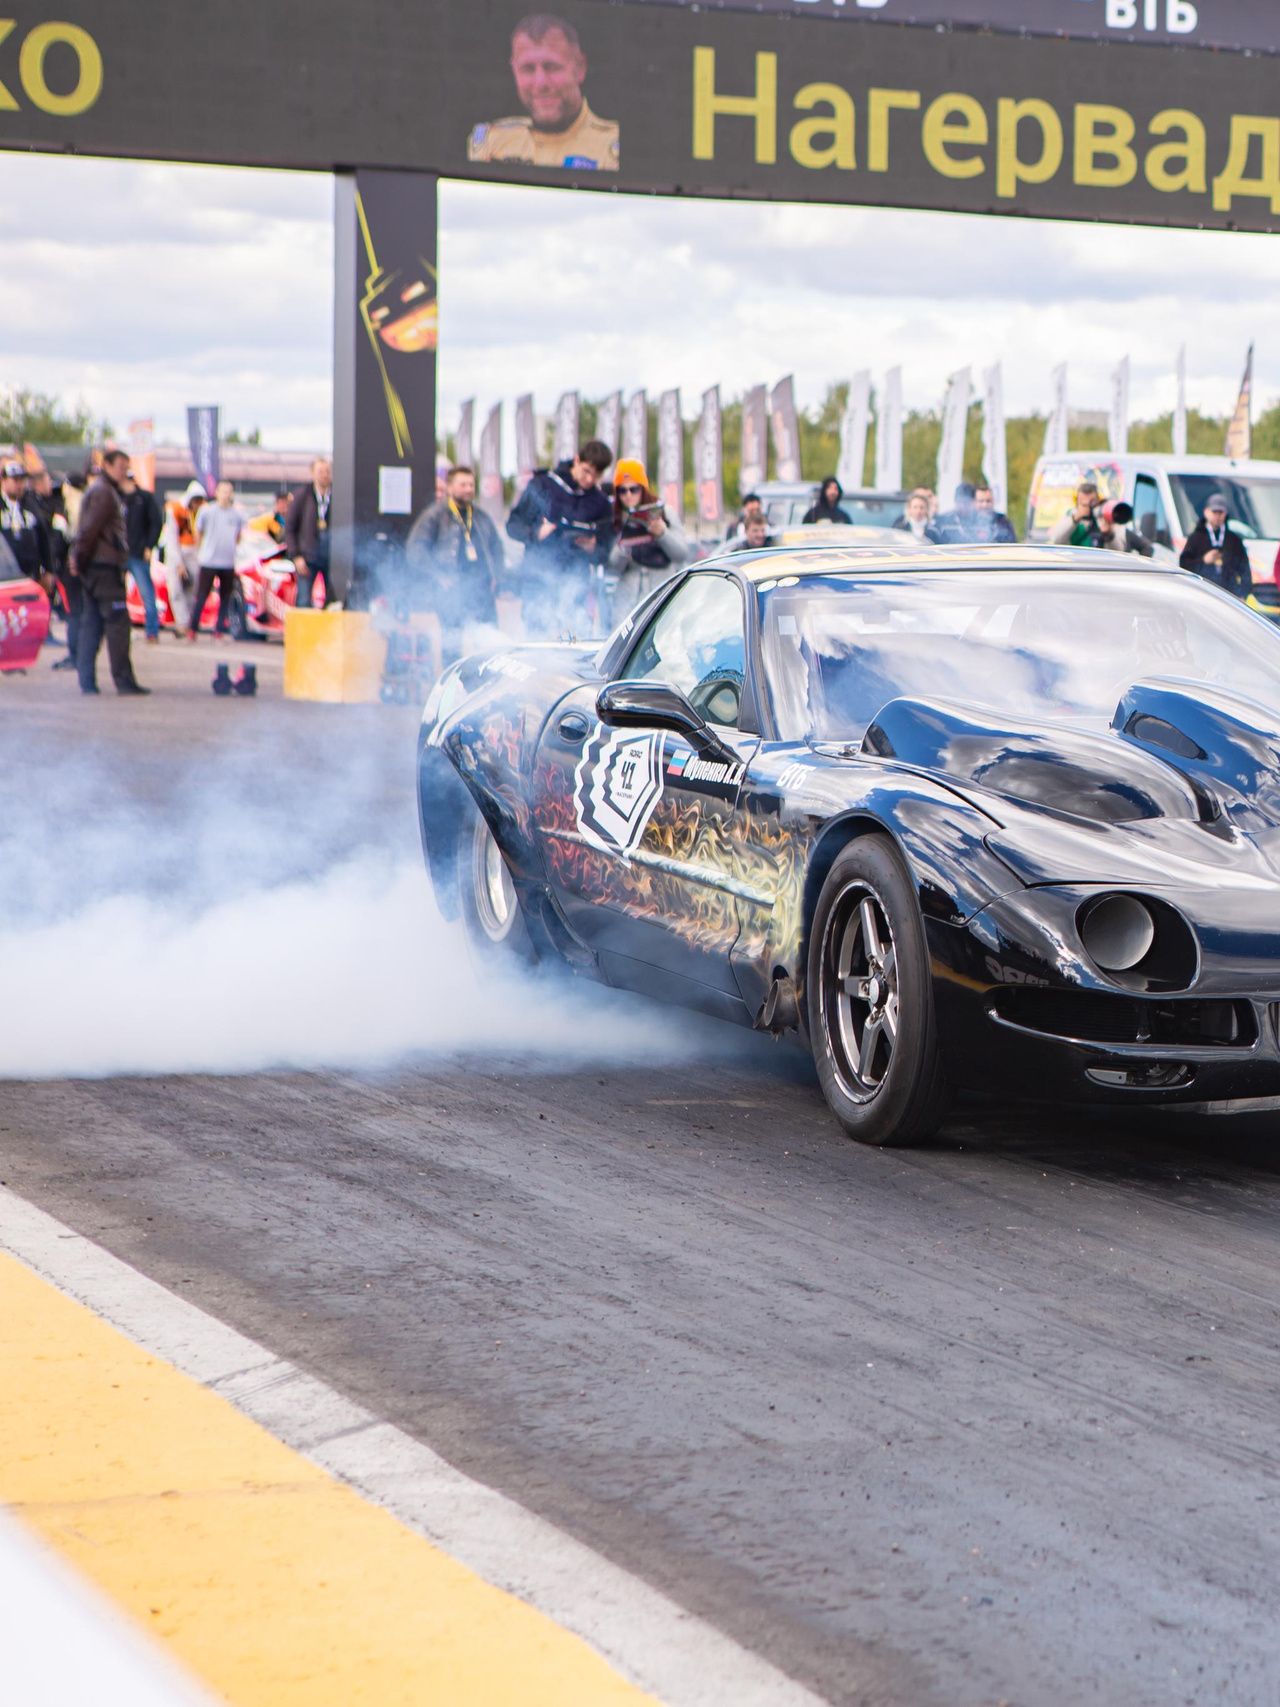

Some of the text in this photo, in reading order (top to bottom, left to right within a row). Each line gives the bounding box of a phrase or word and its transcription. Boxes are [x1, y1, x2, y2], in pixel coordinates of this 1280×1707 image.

[0, 17, 103, 116] о
[621, 761, 636, 790] 41
[683, 755, 729, 782] Муленко
[776, 763, 816, 790] ВТБ
